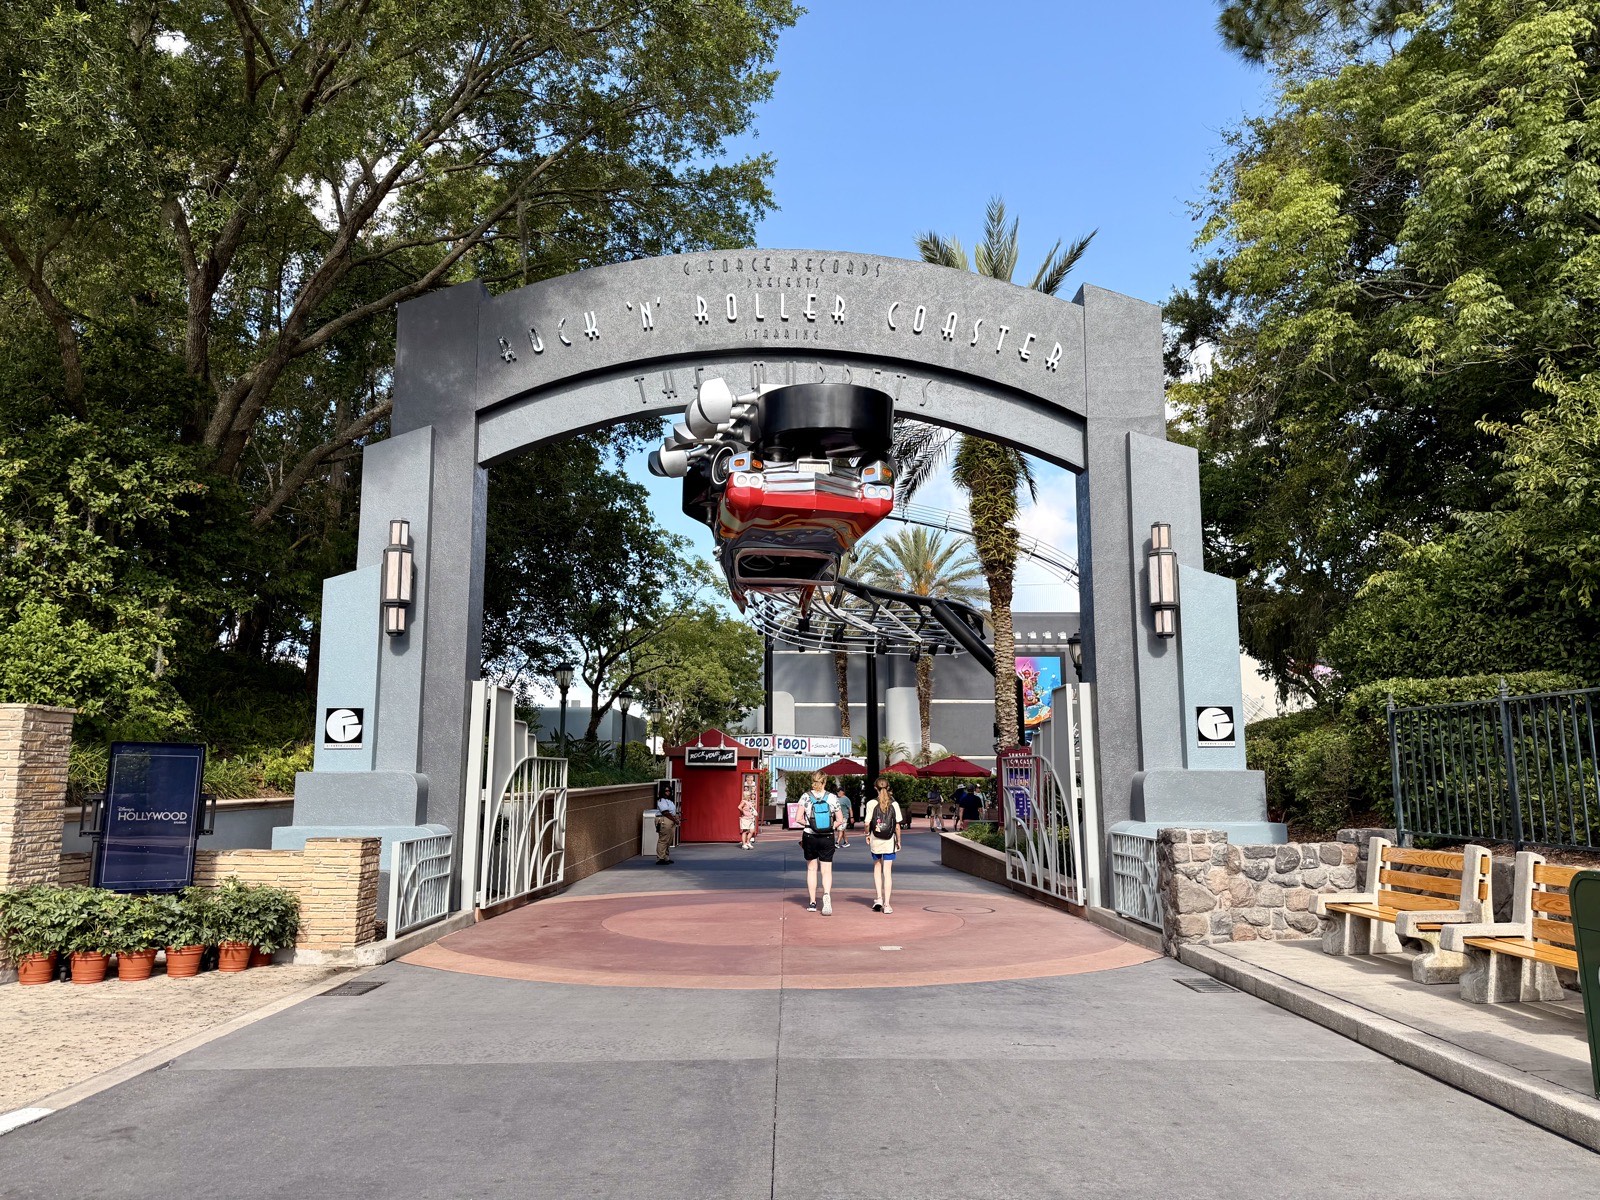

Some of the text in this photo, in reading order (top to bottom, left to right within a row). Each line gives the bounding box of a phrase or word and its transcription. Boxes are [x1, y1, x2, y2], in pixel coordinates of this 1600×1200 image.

[683, 257, 881, 277] G-FORCE RECORDS
[747, 277, 819, 288] PRESENTS
[498, 310, 600, 362] ROCK
[694, 292, 847, 325] ROLLER
[887, 301, 1063, 372] COASTER
[744, 329, 819, 340] STARRING
[689, 750, 734, 762] ROCK YOUR FACE
[118, 812, 188, 821] HOLLYWOOD
